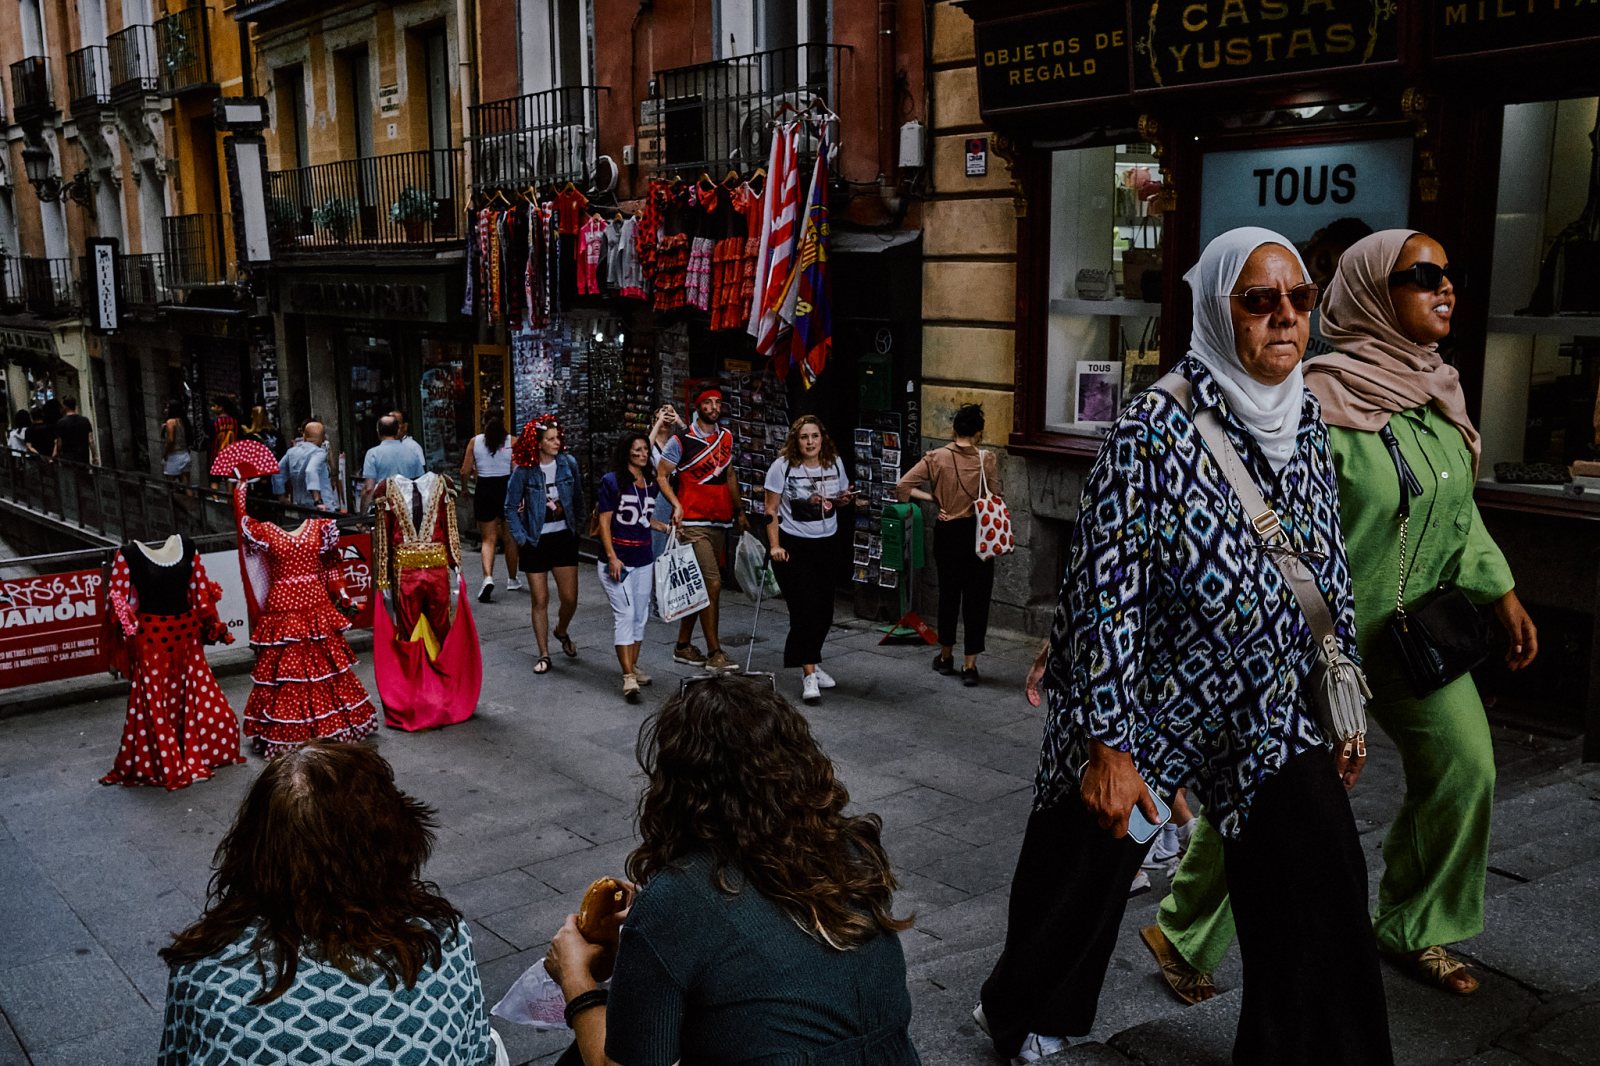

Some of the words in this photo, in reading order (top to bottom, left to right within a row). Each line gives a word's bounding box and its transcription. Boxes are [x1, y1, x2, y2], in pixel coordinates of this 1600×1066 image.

[983, 37, 1081, 67] OBJETOS
[1095, 30, 1124, 50] DE
[1168, 23, 1356, 73] YUSTAS
[1009, 58, 1097, 86] REGALO
[1253, 163, 1356, 206] TOUS
[1088, 364, 1111, 372] TOUS
